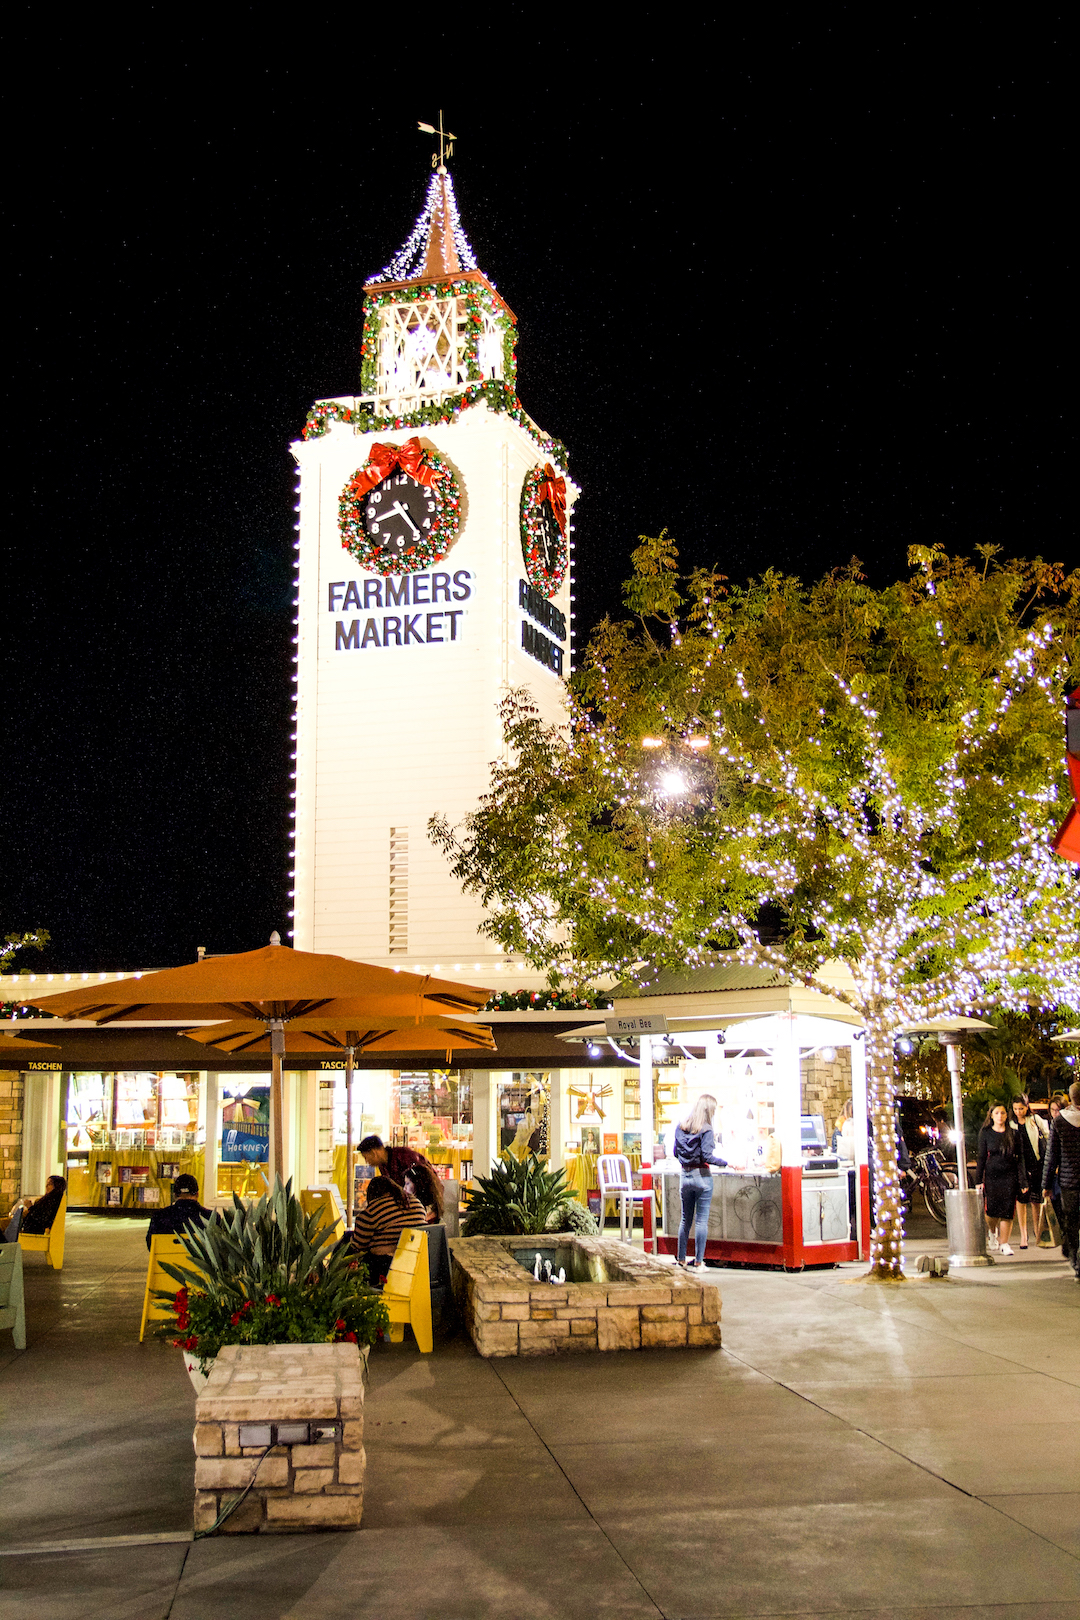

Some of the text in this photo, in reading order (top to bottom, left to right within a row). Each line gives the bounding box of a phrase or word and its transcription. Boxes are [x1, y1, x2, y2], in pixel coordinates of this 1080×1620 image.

[382, 479, 391, 490] 11
[395, 474, 408, 485] 12
[370, 491, 382, 503] 10
[423, 486, 432, 498] 2
[427, 501, 435, 512] 3
[367, 507, 376, 519] 9
[371, 522, 379, 534] 8
[422, 517, 431, 529] 4
[383, 533, 391, 544] 7
[396, 535, 405, 547] 6
[412, 530, 420, 541] 5
[328, 570, 472, 612] FARMERS
[335, 610, 463, 651] MARKET
[618, 1019, 652, 1030] Royal Bee
[320, 1061, 359, 1070] TASCHN
[652, 1056, 687, 1064] ASCHE
[28, 1062, 63, 1070] TASCHEN
[228, 1143, 269, 1153] HOCKNEY
